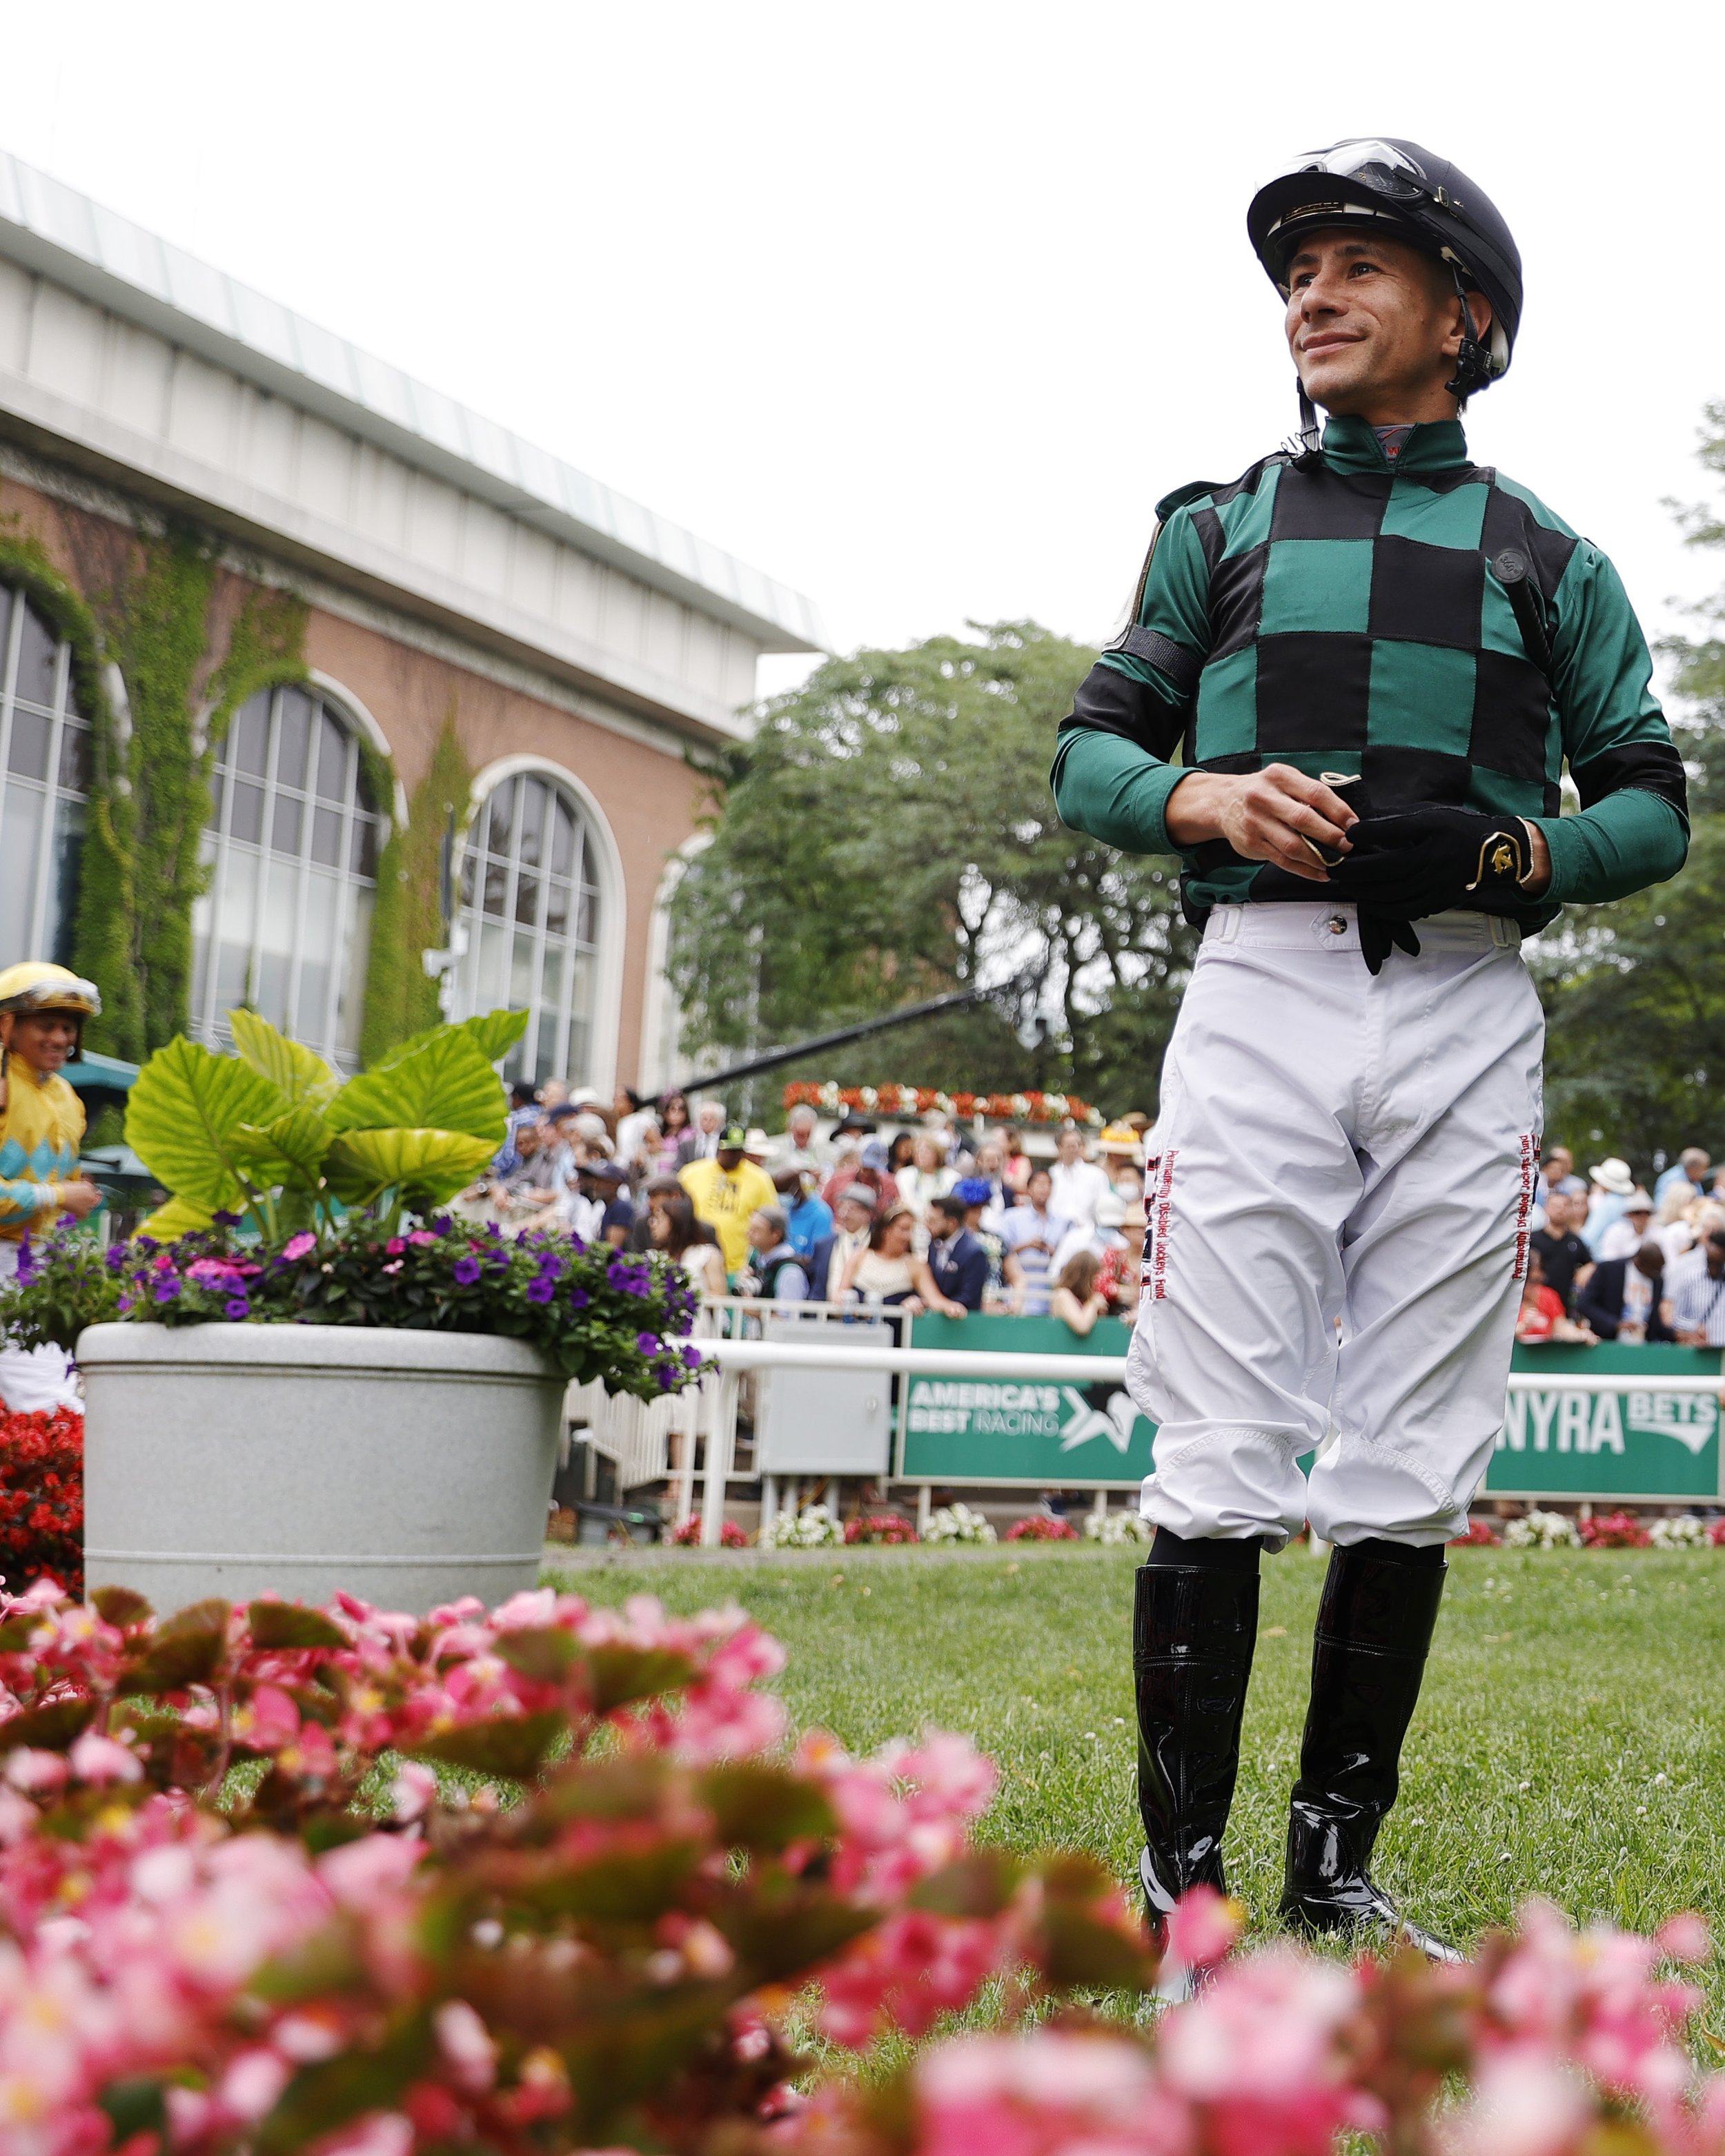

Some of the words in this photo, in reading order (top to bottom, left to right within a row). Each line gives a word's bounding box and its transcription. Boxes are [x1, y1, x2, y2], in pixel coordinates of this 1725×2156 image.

[1519, 1135, 1529, 1155] Fund
[1157, 1150, 1179, 1198] Permanently
[1521, 1157, 1531, 1190] Jockeys
[1156, 1203, 1171, 1238] Disabled
[1517, 1193, 1530, 1228] Disabled
[1153, 1242, 1170, 1275] Jockeys
[1512, 1231, 1529, 1280] Permanently
[1155, 1279, 1167, 1300] Fund
[911, 1382, 1061, 1411] AMERICA'S
[909, 1409, 969, 1433] BEST
[974, 1410, 1059, 1437] RACING
[1495, 1390, 1626, 1455] NYRA
[1628, 1391, 1717, 1423] BETS
